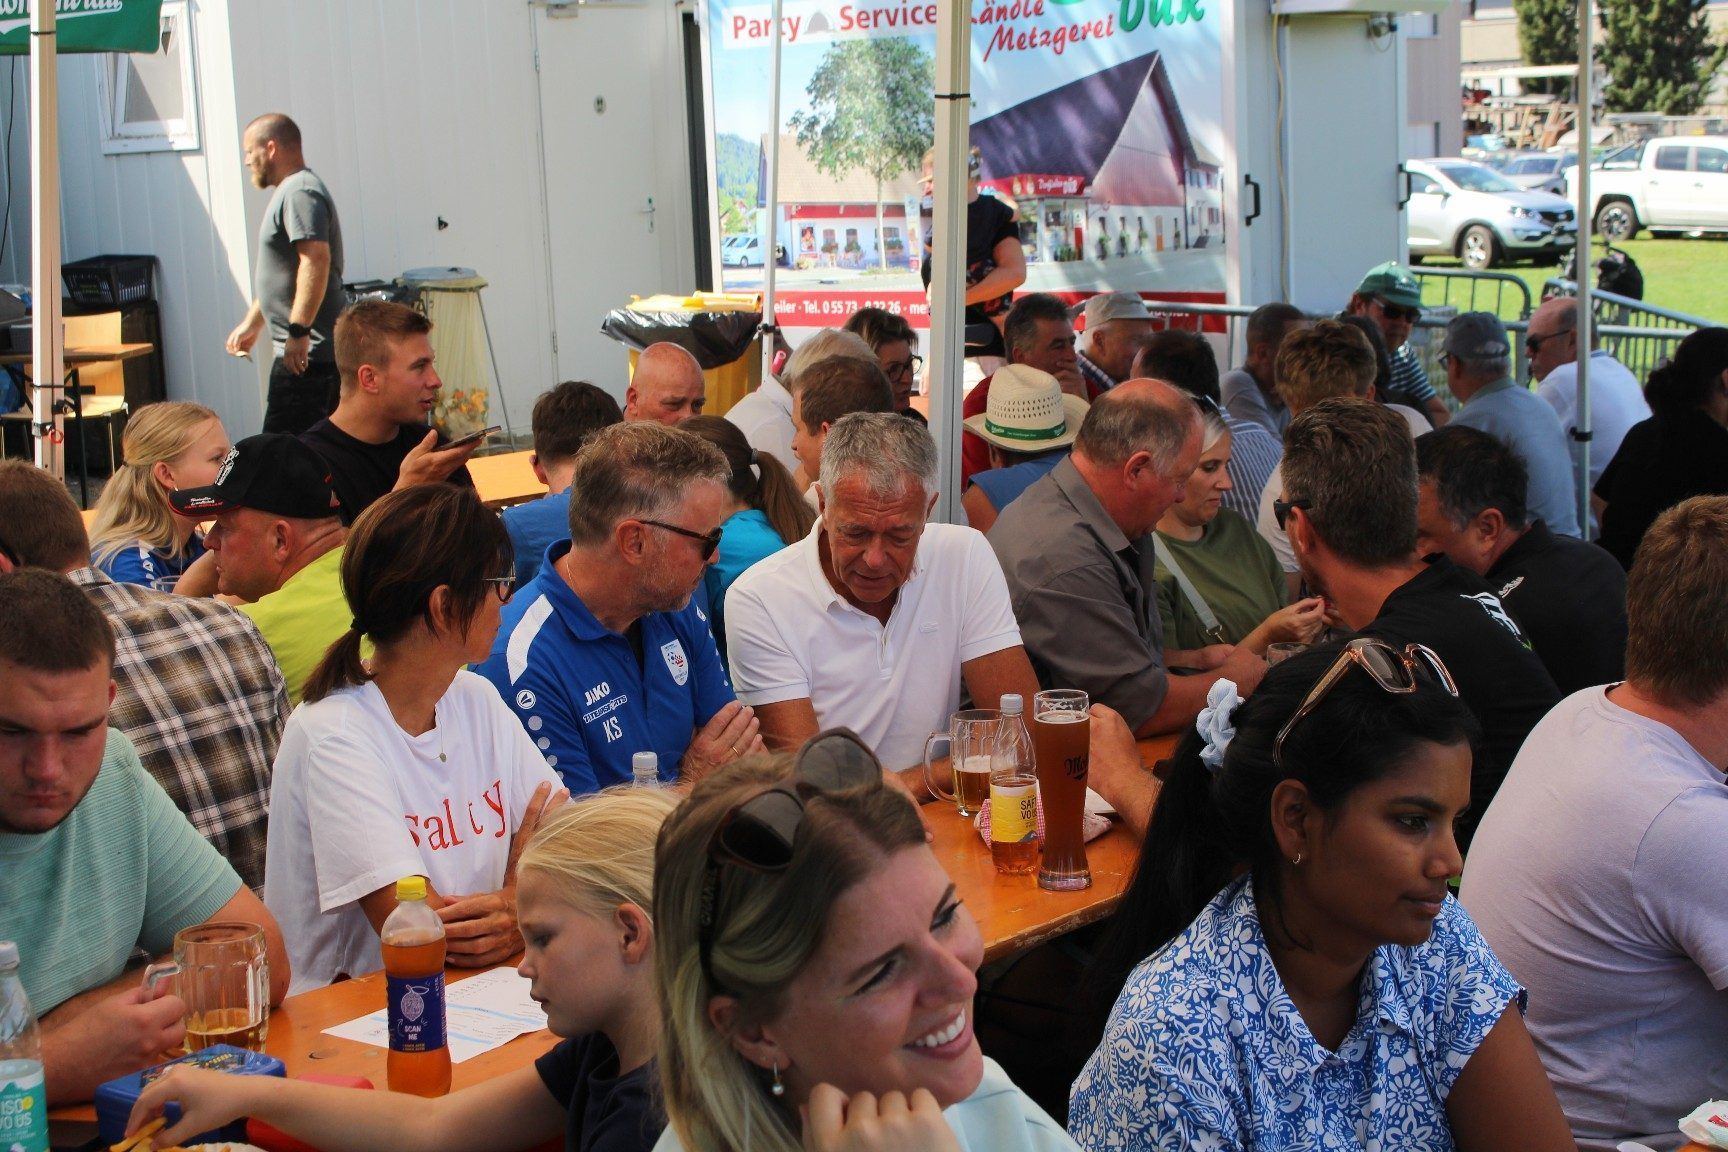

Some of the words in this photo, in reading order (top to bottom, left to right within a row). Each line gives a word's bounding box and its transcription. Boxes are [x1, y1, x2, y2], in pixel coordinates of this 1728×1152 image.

[840, 4, 937, 31] Service
[971, 0, 1045, 24] ändle
[983, 14, 1113, 62] Metzgerei
[803, 300, 820, 314] Tel.
[831, 300, 843, 314] 55
[585, 682, 611, 706] JAKO
[602, 716, 623, 743] KS
[404, 1025, 422, 1033] SCAN
